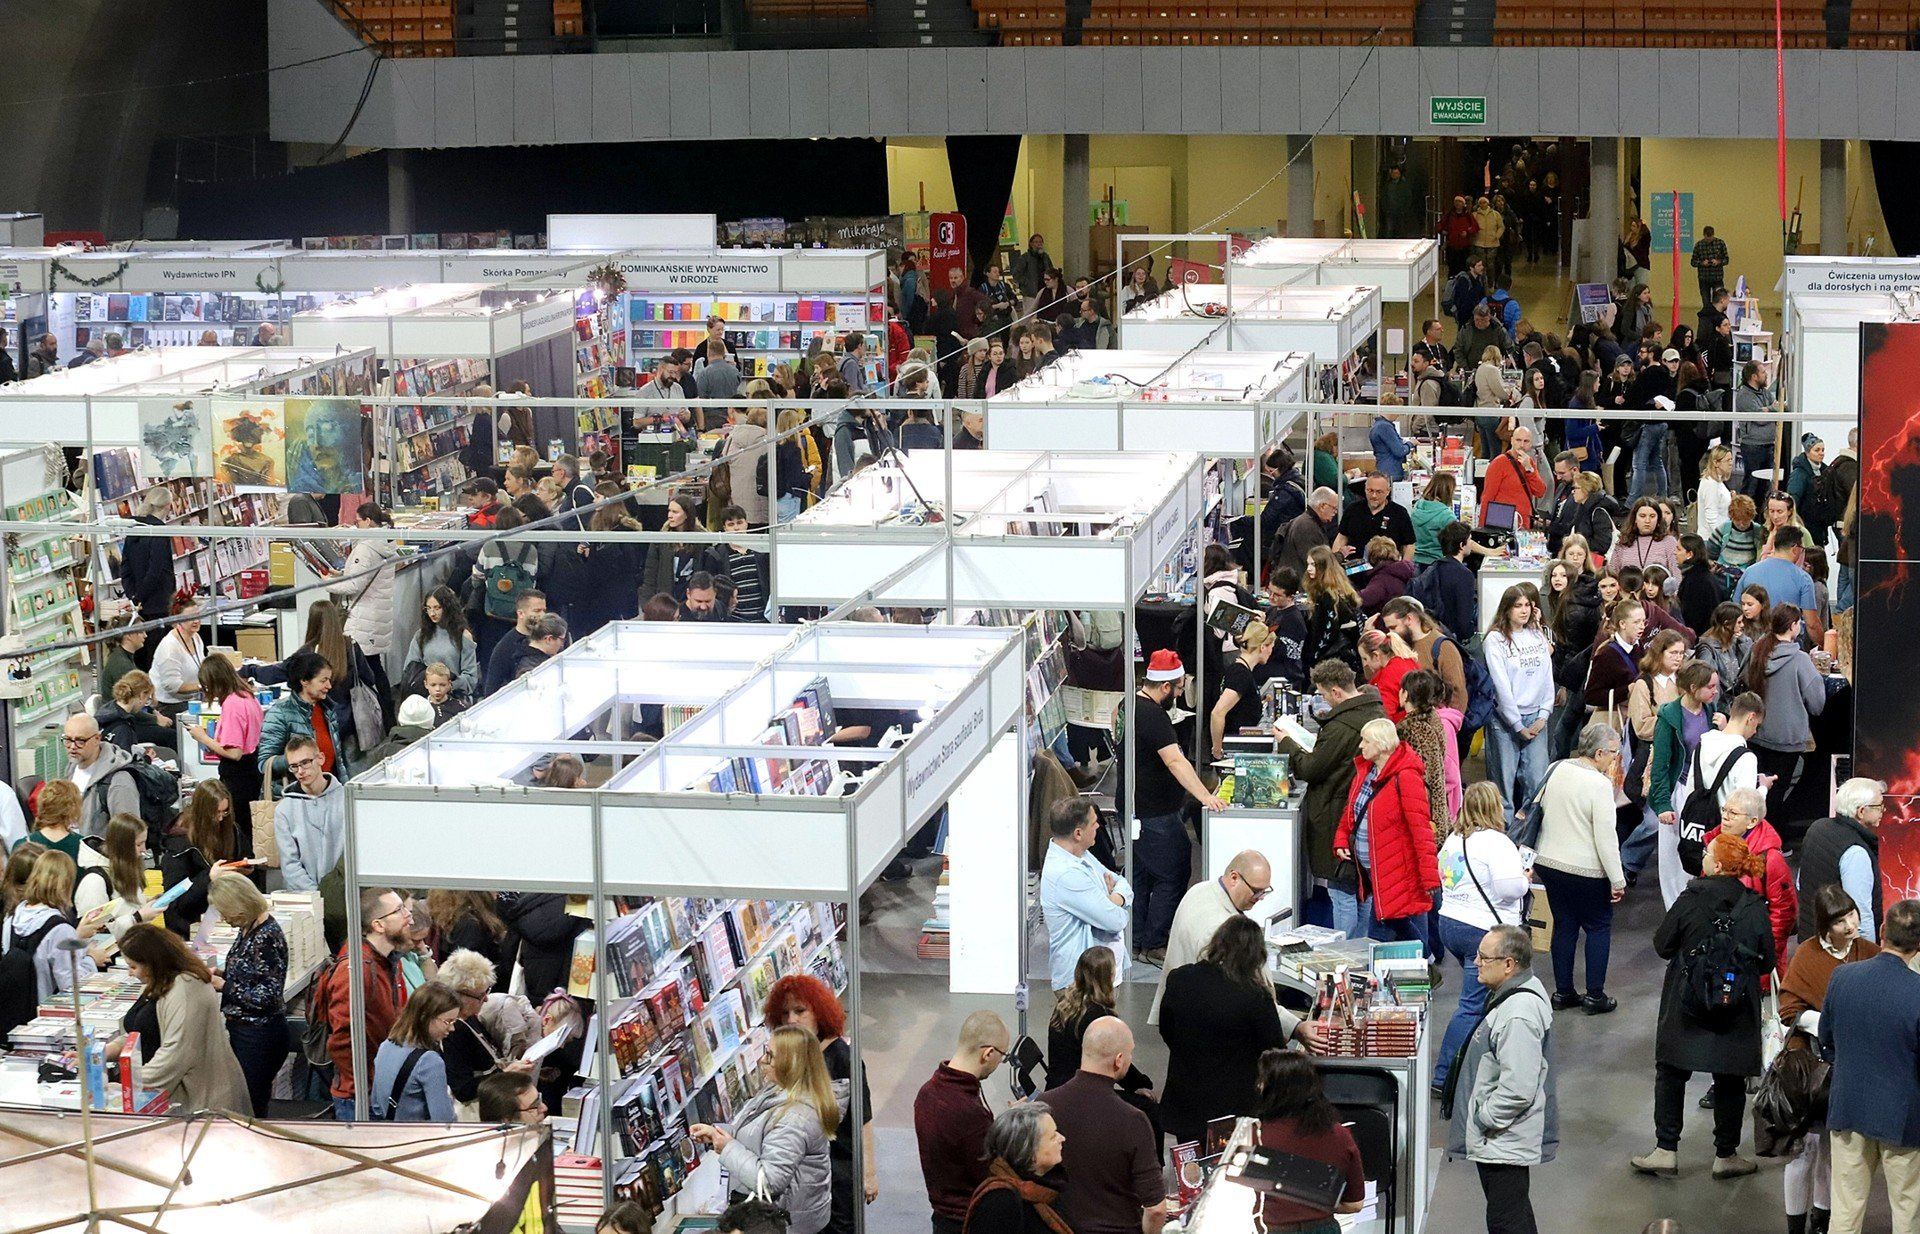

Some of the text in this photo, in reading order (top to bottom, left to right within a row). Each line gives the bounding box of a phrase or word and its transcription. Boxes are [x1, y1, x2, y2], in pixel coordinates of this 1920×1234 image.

[1436, 101, 1481, 111] WYJŚCIE
[483, 268, 513, 276] Skórka
[620, 263, 768, 273] DOMINIKAŃSKIE WYDAWNICTWO
[163, 270, 236, 280] Wydawnictwo IPN
[1828, 269, 1876, 280] Ćwiczenia
[1807, 282, 1822, 291] dla
[1824, 282, 1872, 293] dorosłych
[1520, 656, 1541, 668] PARIS
[907, 754, 941, 799] Wydawnictwo
